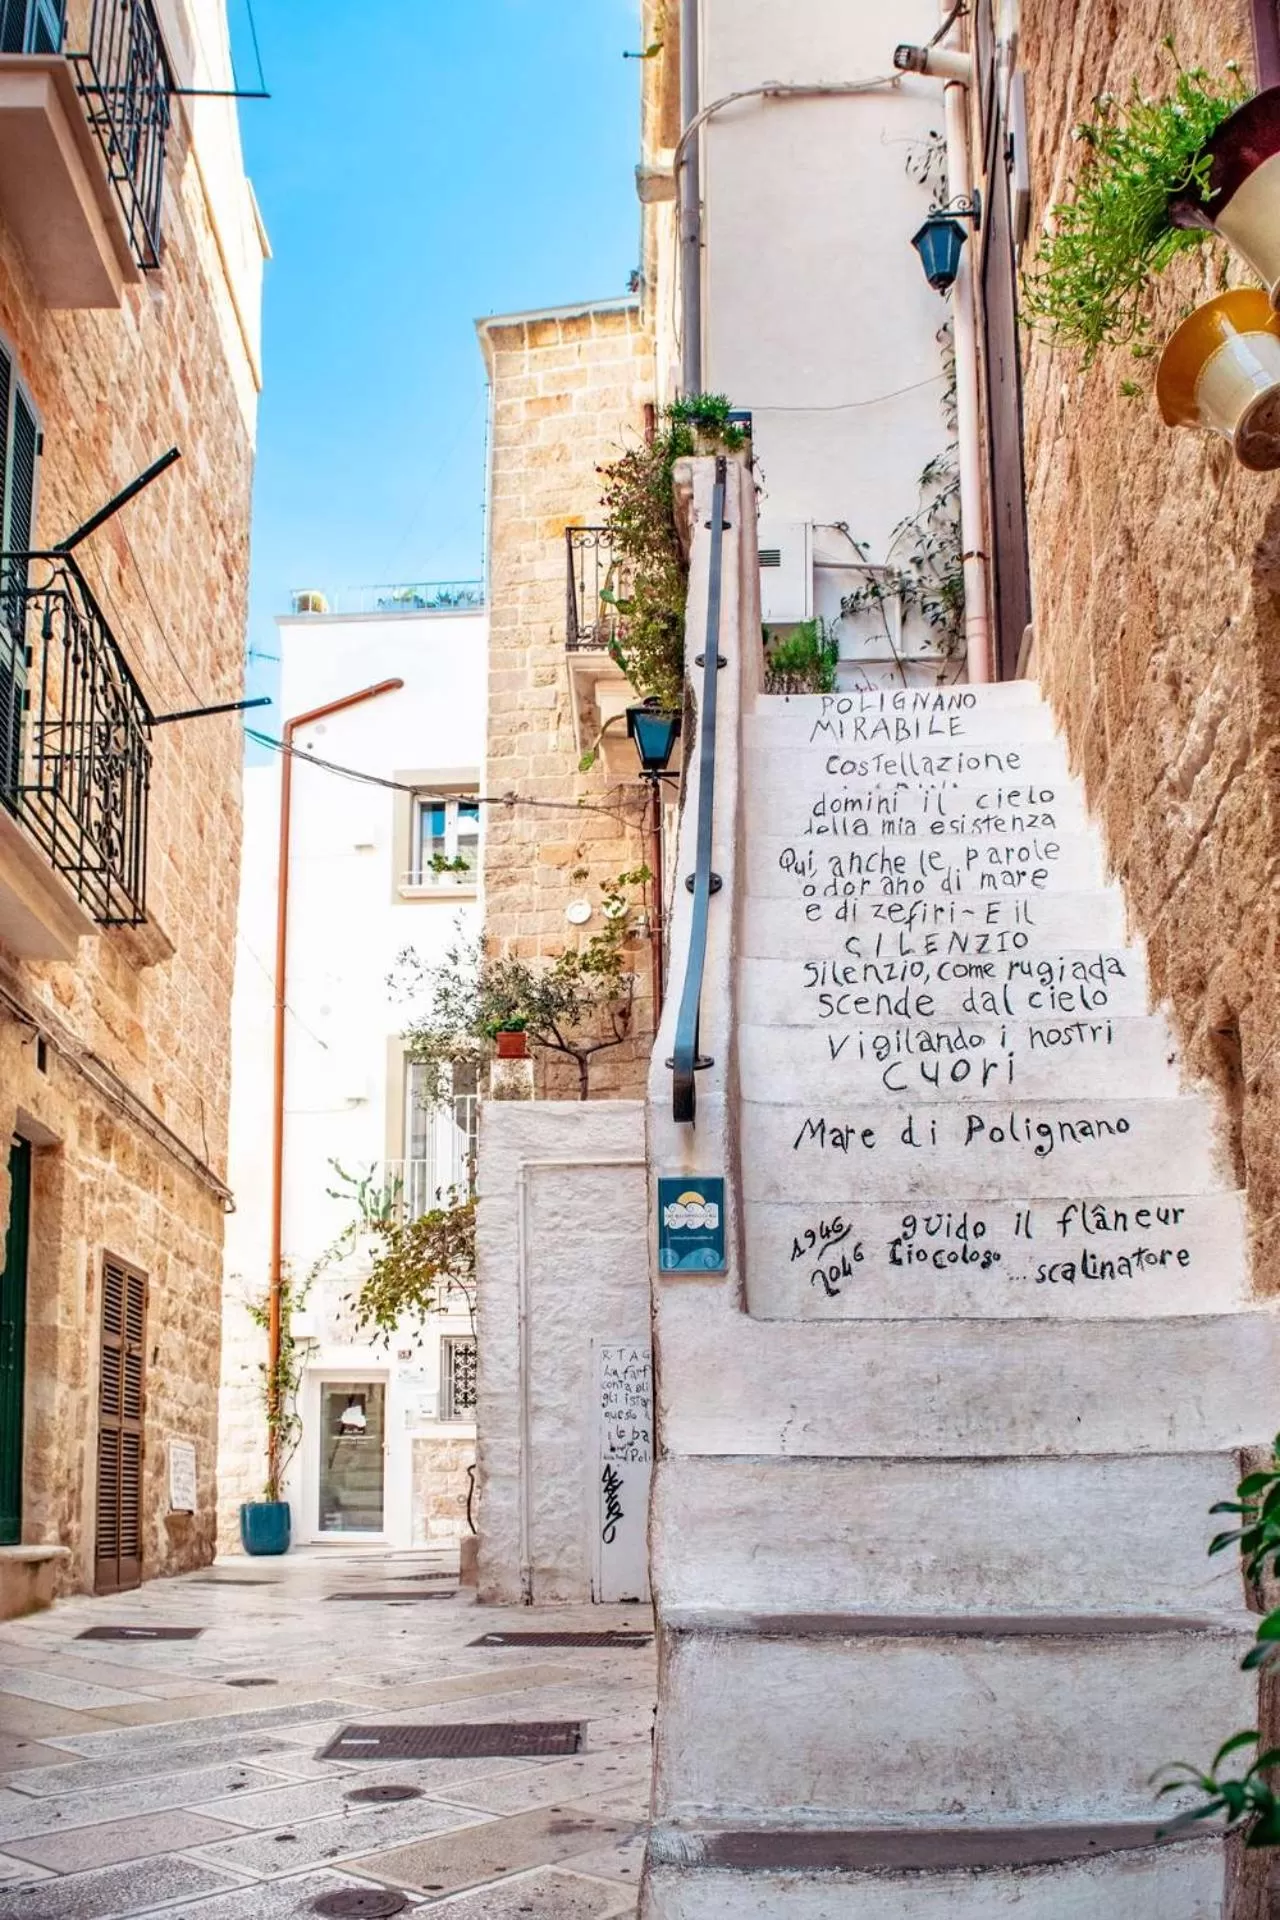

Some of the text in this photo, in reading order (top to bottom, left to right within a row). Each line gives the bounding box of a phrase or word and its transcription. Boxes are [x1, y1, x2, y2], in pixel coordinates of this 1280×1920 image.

[820, 692, 976, 716] POLIGNANO
[810, 716, 966, 742] MIRABILE
[813, 785, 1055, 818] domini il cielo
[882, 817, 916, 836] mia
[930, 813, 1056, 836] esistenza
[828, 845, 906, 878] anche
[942, 866, 962, 894] di
[981, 866, 1049, 890] mare
[805, 903, 822, 922] e
[836, 898, 857, 922] di
[986, 902, 1001, 924] E
[1015, 900, 1036, 925] il
[936, 963, 995, 981] come
[1008, 953, 1127, 985] rugiada
[962, 990, 1012, 1016] dal
[1028, 985, 1108, 1014] cielo
[1000, 1024, 1008, 1049] i
[793, 1113, 1130, 1157] Mare di Polignano
[1014, 1209, 1033, 1239] il
[1057, 1201, 1185, 1238] flâneur
